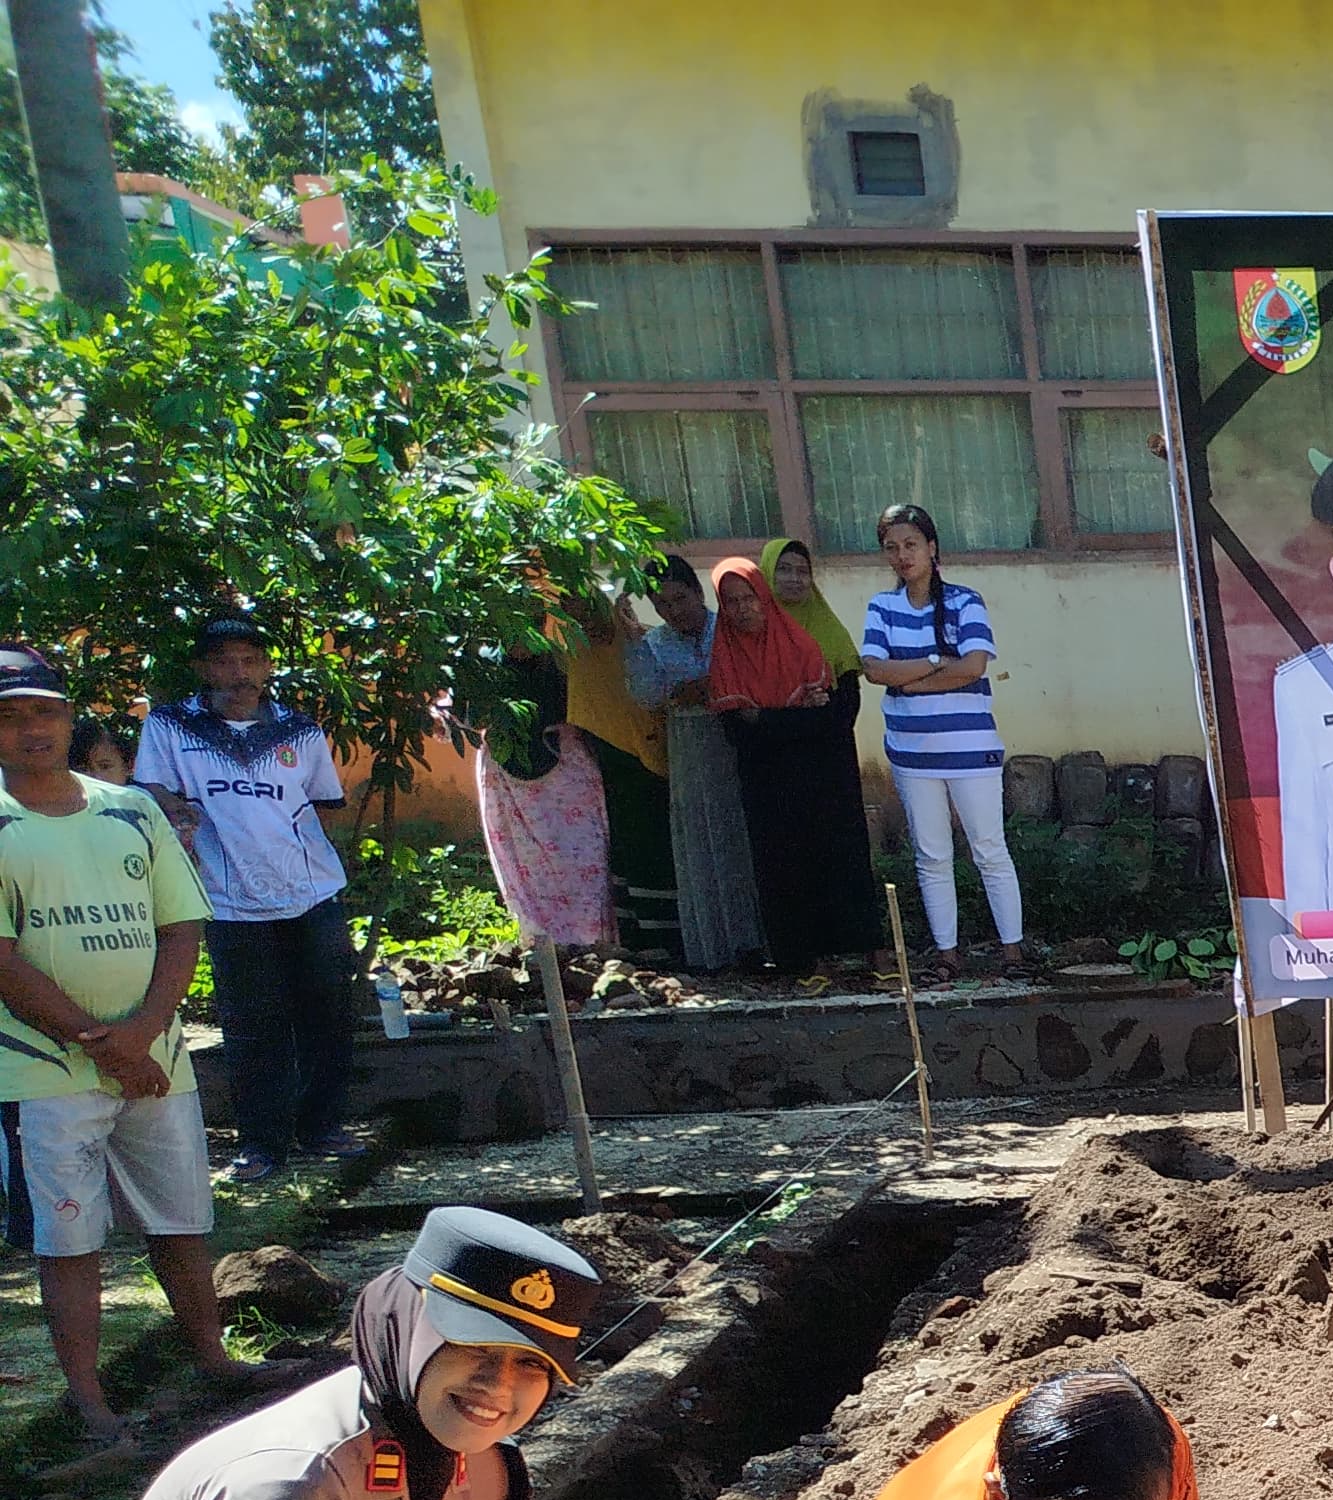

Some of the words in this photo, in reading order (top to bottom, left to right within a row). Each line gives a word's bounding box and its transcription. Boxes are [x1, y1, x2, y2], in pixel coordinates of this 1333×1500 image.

[206, 779, 284, 801] PGRI
[30, 902, 148, 929] SAMSUNG
[81, 926, 152, 952] mobile
